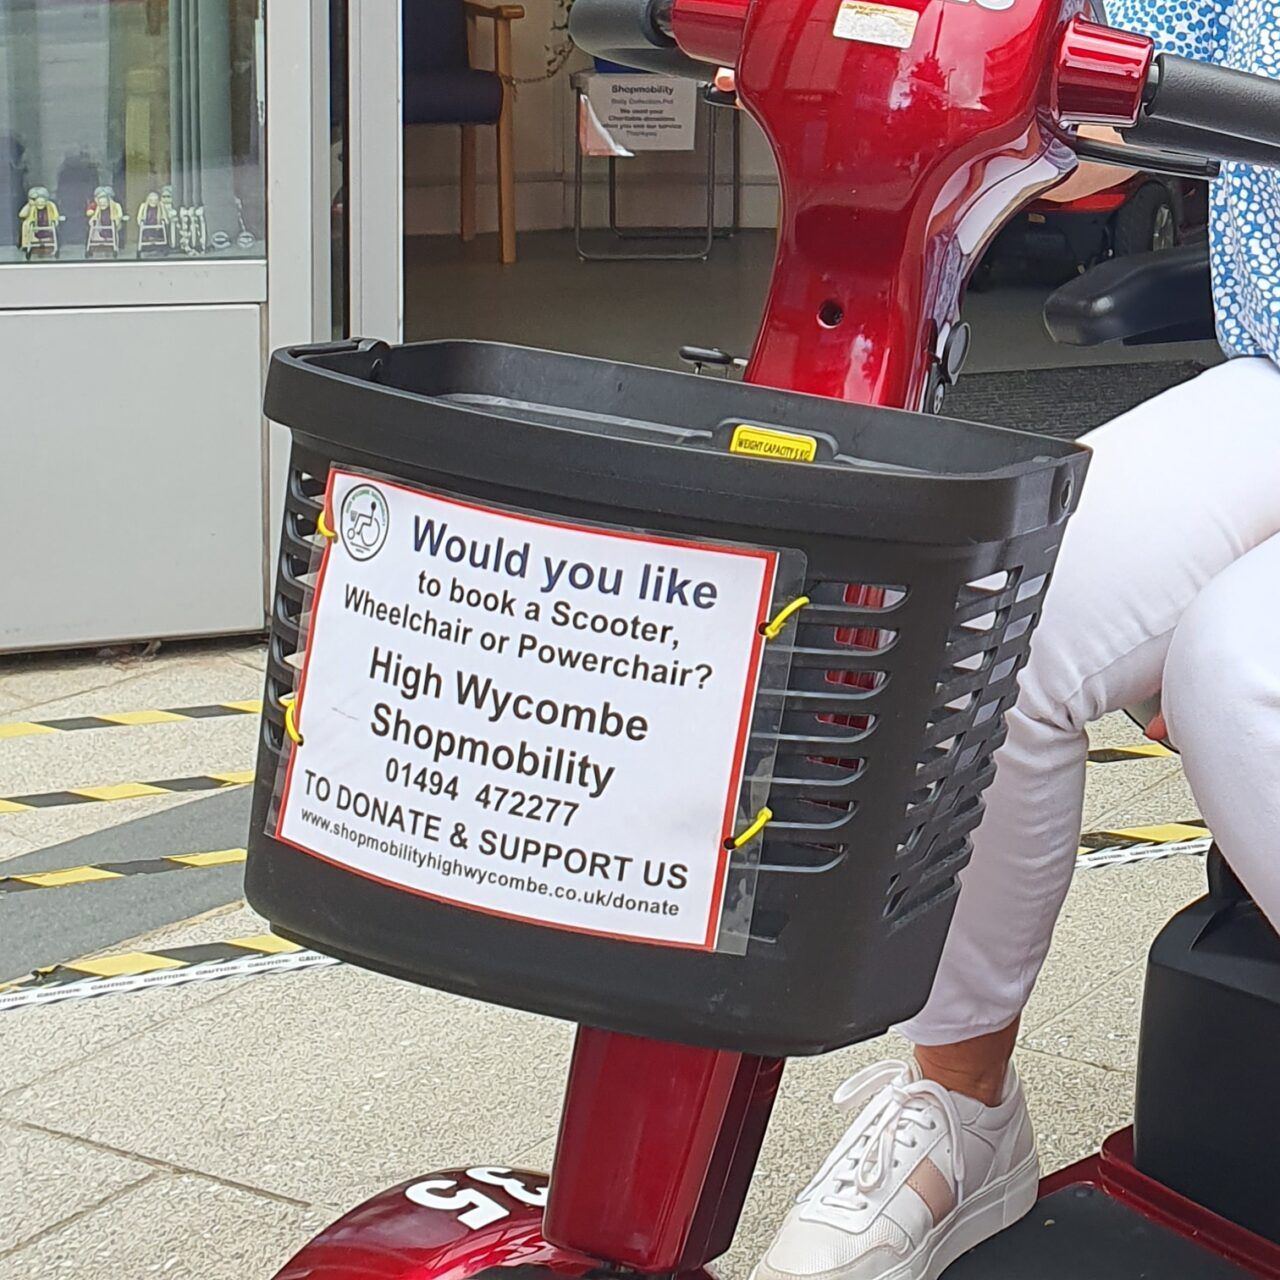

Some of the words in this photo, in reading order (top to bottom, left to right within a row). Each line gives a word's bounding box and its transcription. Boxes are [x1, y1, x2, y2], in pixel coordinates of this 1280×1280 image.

[611, 84, 674, 96] Shopmobility
[738, 439, 763, 452] WEIGHT
[763, 442, 794, 457] CAPACITY
[413, 515, 530, 578] Would
[539, 553, 622, 596] you
[639, 563, 719, 610] like
[417, 570, 441, 597] to
[449, 578, 516, 617] book
[525, 602, 541, 622] a
[551, 600, 681, 650] Scooter,
[343, 583, 473, 646] Wheelchair
[480, 630, 510, 654] or
[518, 634, 714, 690] Powerchair?
[368, 645, 443, 700] High
[456, 670, 649, 742] Wycombe
[370, 702, 616, 798] Shopmobility
[385, 756, 460, 802] 01494
[475, 784, 580, 827] 472277
[300, 808, 681, 917] www.shopmobilityhighwycombe.co.uk/donate
[304, 769, 330, 802] TO
[336, 783, 443, 842] DONATE
[449, 822, 470, 850] &
[477, 829, 634, 882] SUPPORT
[642, 860, 690, 890] US
